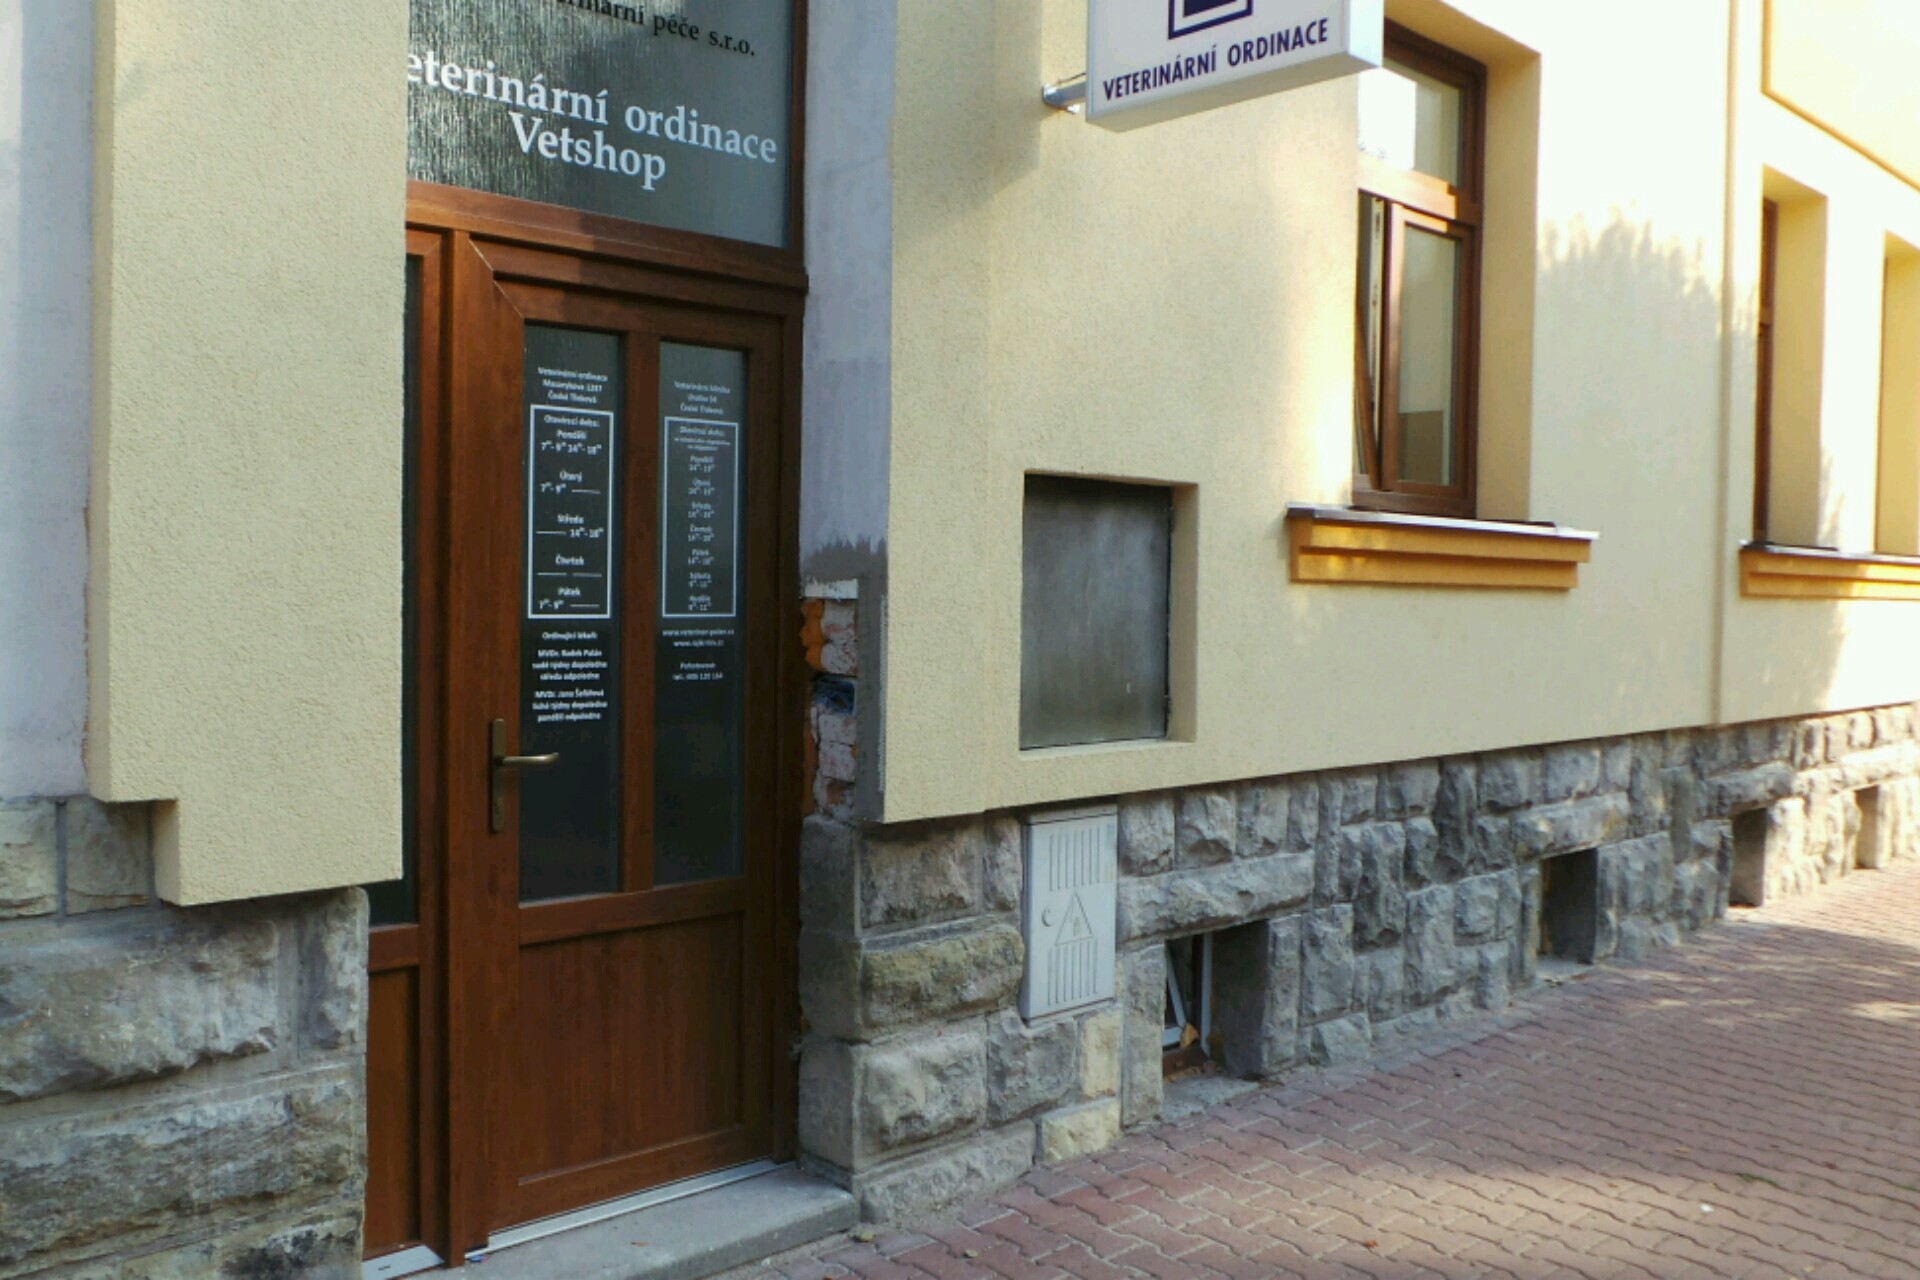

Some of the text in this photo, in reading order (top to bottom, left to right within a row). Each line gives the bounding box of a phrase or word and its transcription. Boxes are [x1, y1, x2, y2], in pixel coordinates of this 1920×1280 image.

[653, 14, 700, 40] péče
[708, 30, 756, 56] s.r.o.
[1103, 18, 1328, 101] VETERINÁRNÍ ORDINACE
[509, 111, 667, 191] Vetshop
[625, 105, 778, 163] ordinace
